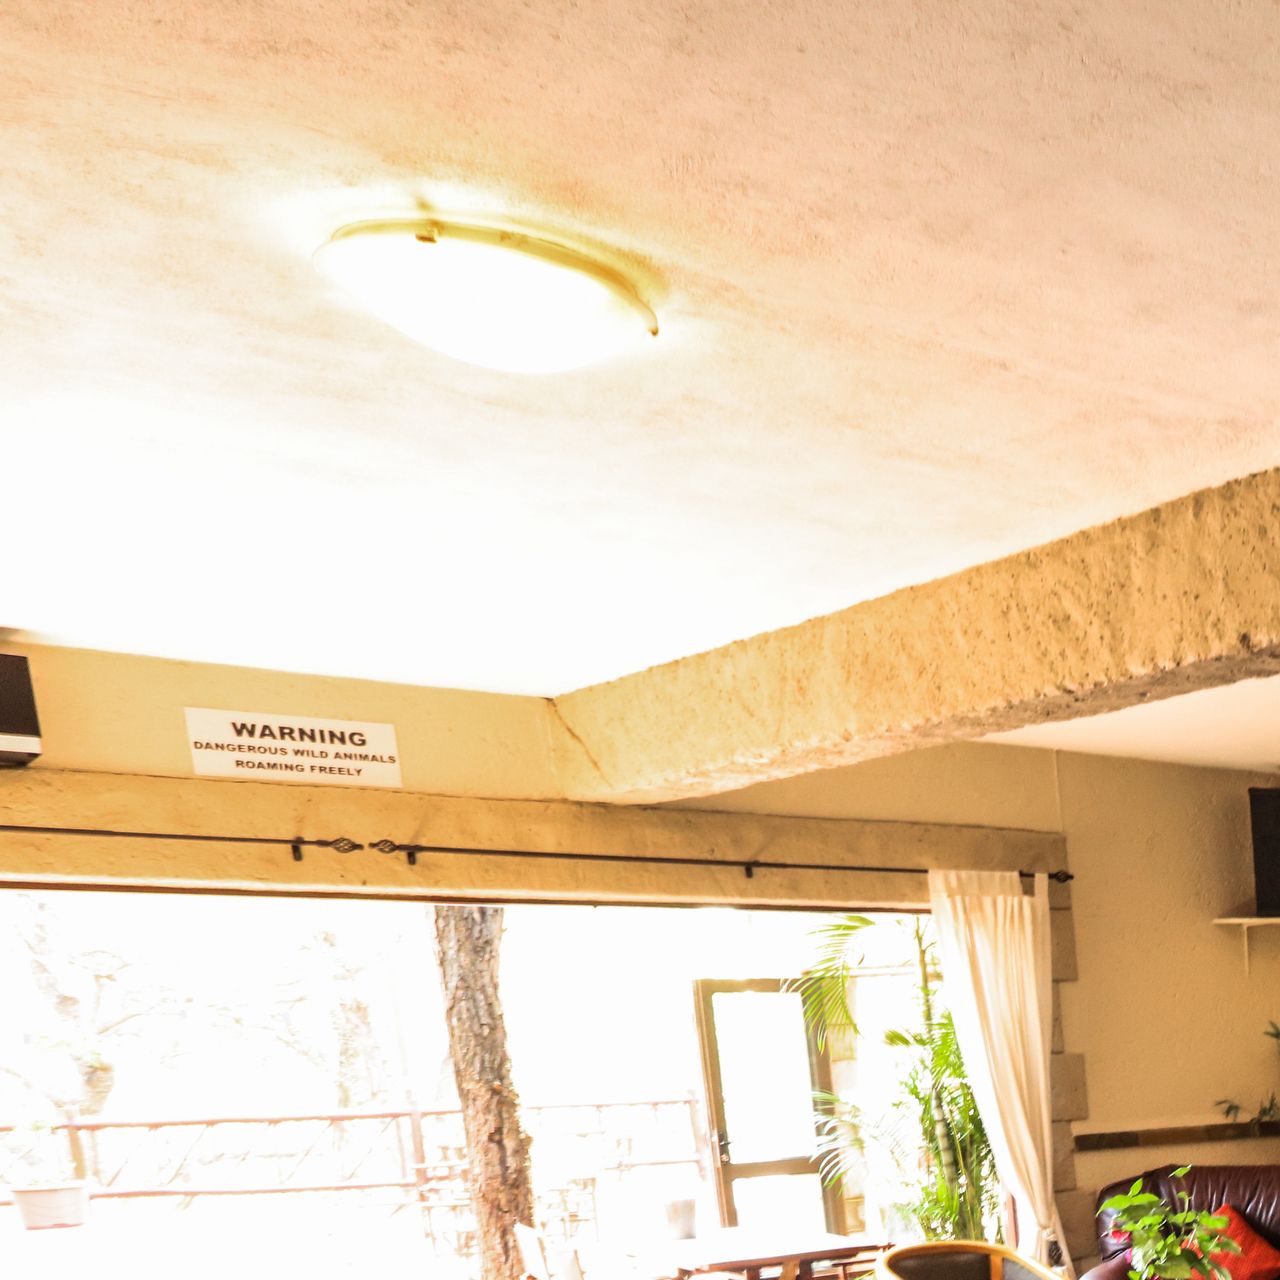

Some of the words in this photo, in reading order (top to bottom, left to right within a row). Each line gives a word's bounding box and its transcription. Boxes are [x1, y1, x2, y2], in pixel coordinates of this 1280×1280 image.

[231, 721, 367, 747] WARNING
[193, 741, 288, 756] DANGEROUS
[293, 748, 329, 759] WILD
[334, 752, 396, 764] ANIMALS
[235, 760, 305, 773] ROAMING
[310, 765, 363, 777] FREELY
